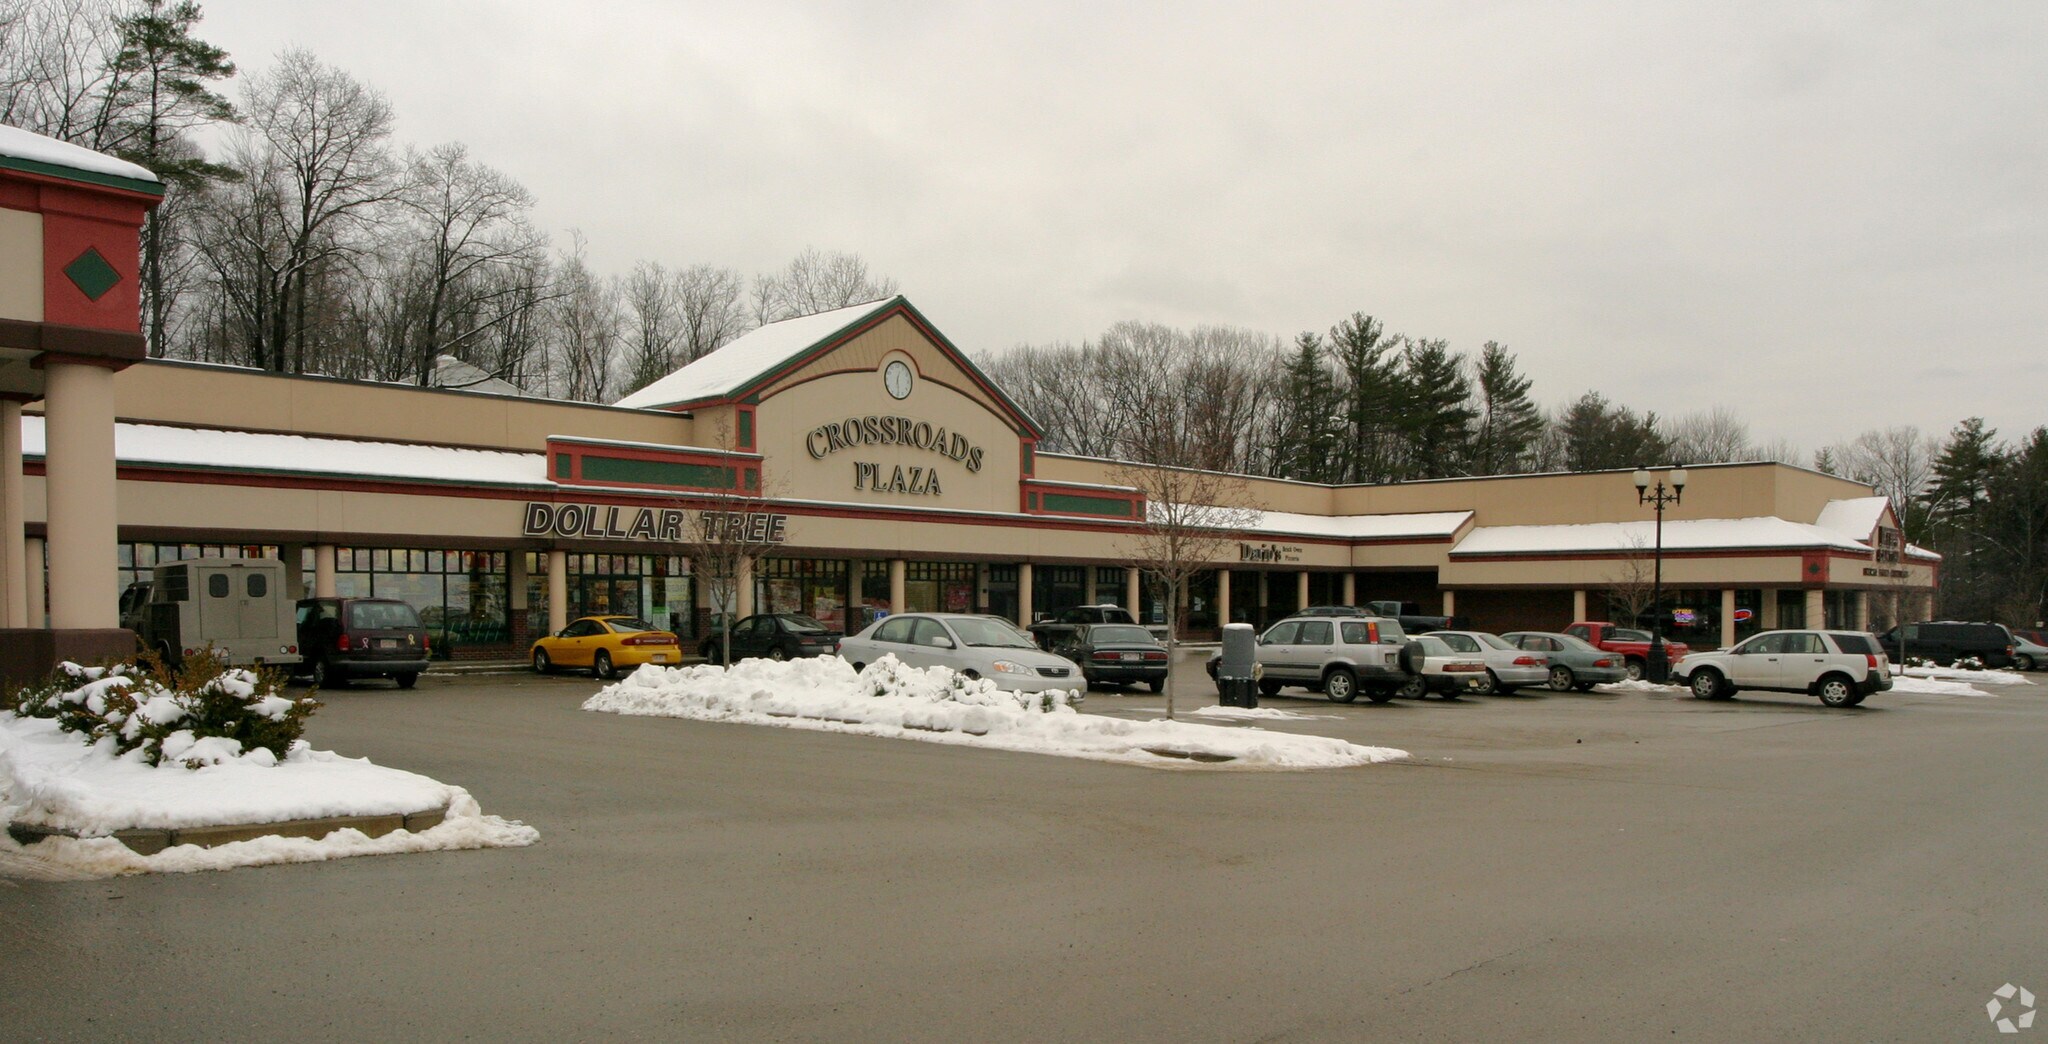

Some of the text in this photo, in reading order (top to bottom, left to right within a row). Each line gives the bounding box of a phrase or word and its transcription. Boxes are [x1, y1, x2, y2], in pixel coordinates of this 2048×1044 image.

[806, 415, 985, 474] CROSSROADS
[853, 460, 943, 497] PLAZA
[524, 501, 788, 543] DOLLAR TREE
